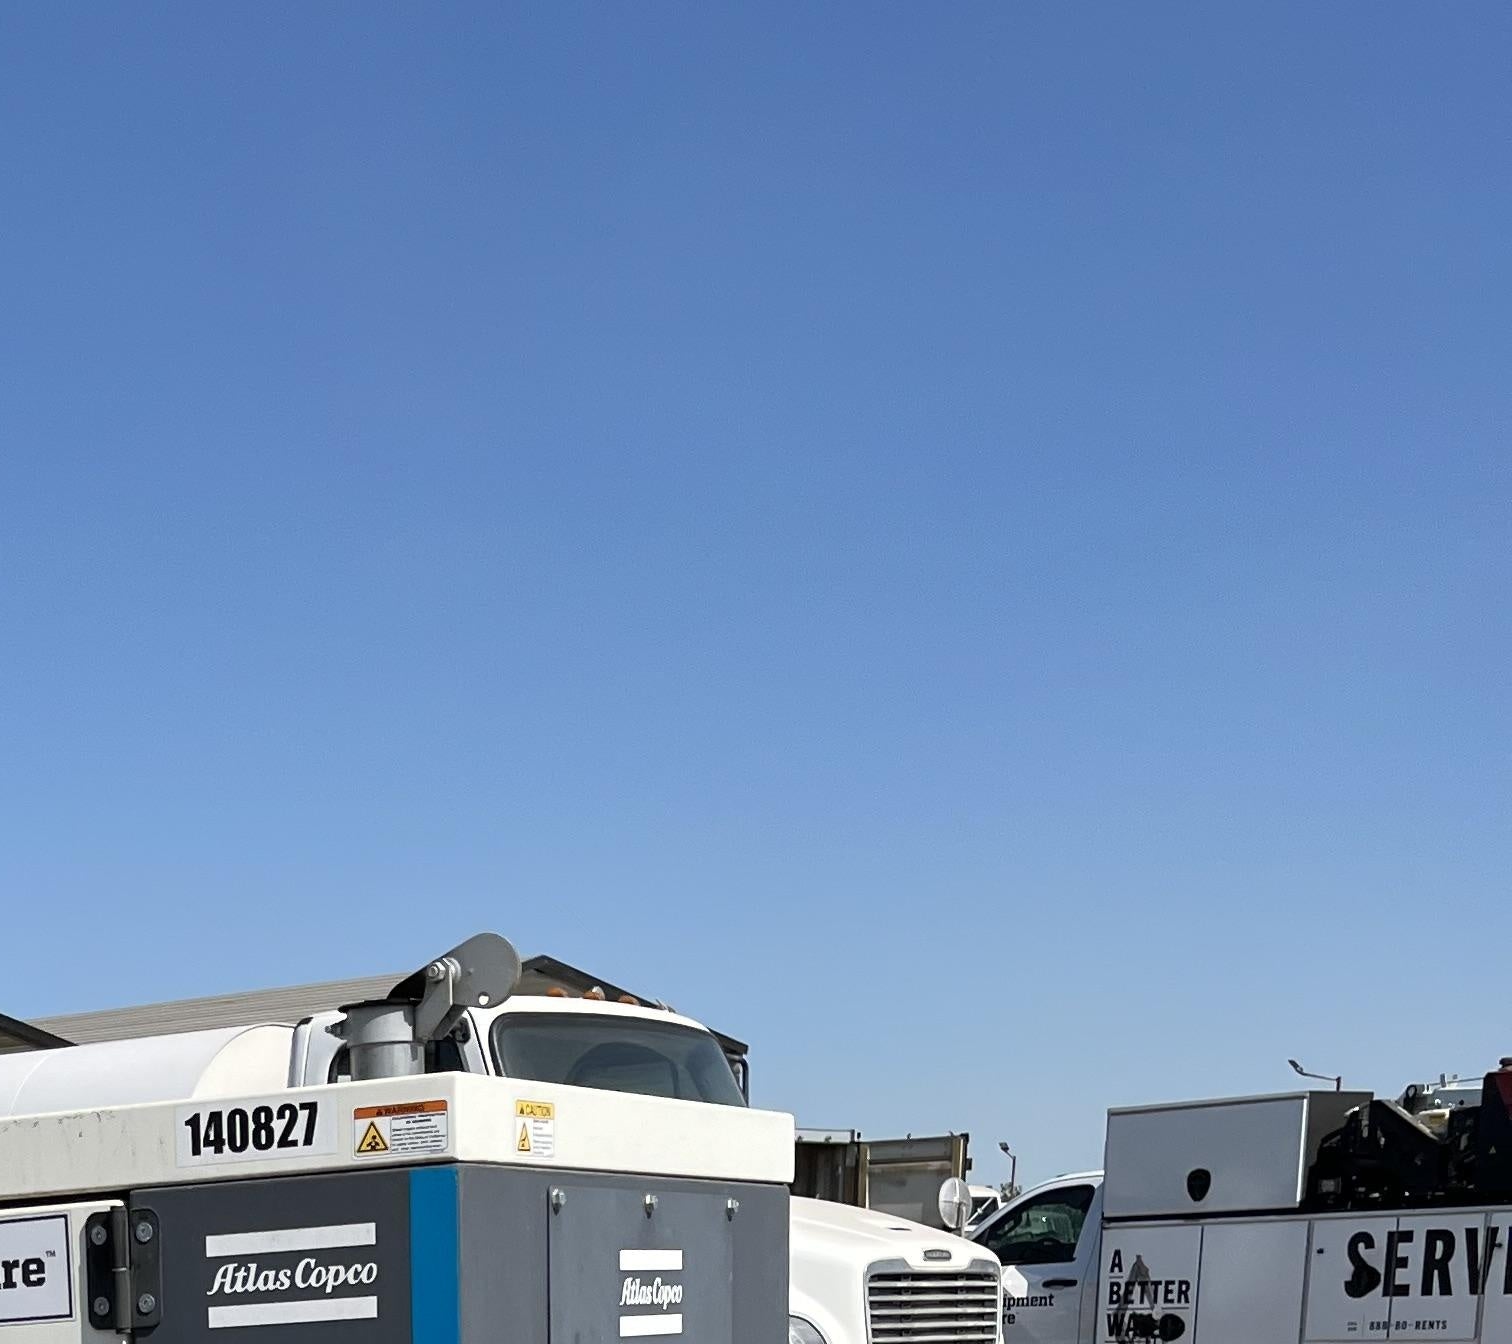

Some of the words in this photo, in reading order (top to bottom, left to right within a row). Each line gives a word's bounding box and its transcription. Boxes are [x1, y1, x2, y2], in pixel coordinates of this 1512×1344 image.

[184, 1101, 318, 1156] 140827
[1110, 1249, 1123, 1273] A
[206, 1263, 292, 1295] Atlas
[294, 1258, 378, 1293] Copco
[619, 1276, 653, 1306] Atlas
[652, 1276, 683, 1310] Copco
[1002, 1293, 1055, 1311] ipment
[1108, 1279, 1191, 1305] BETTER
